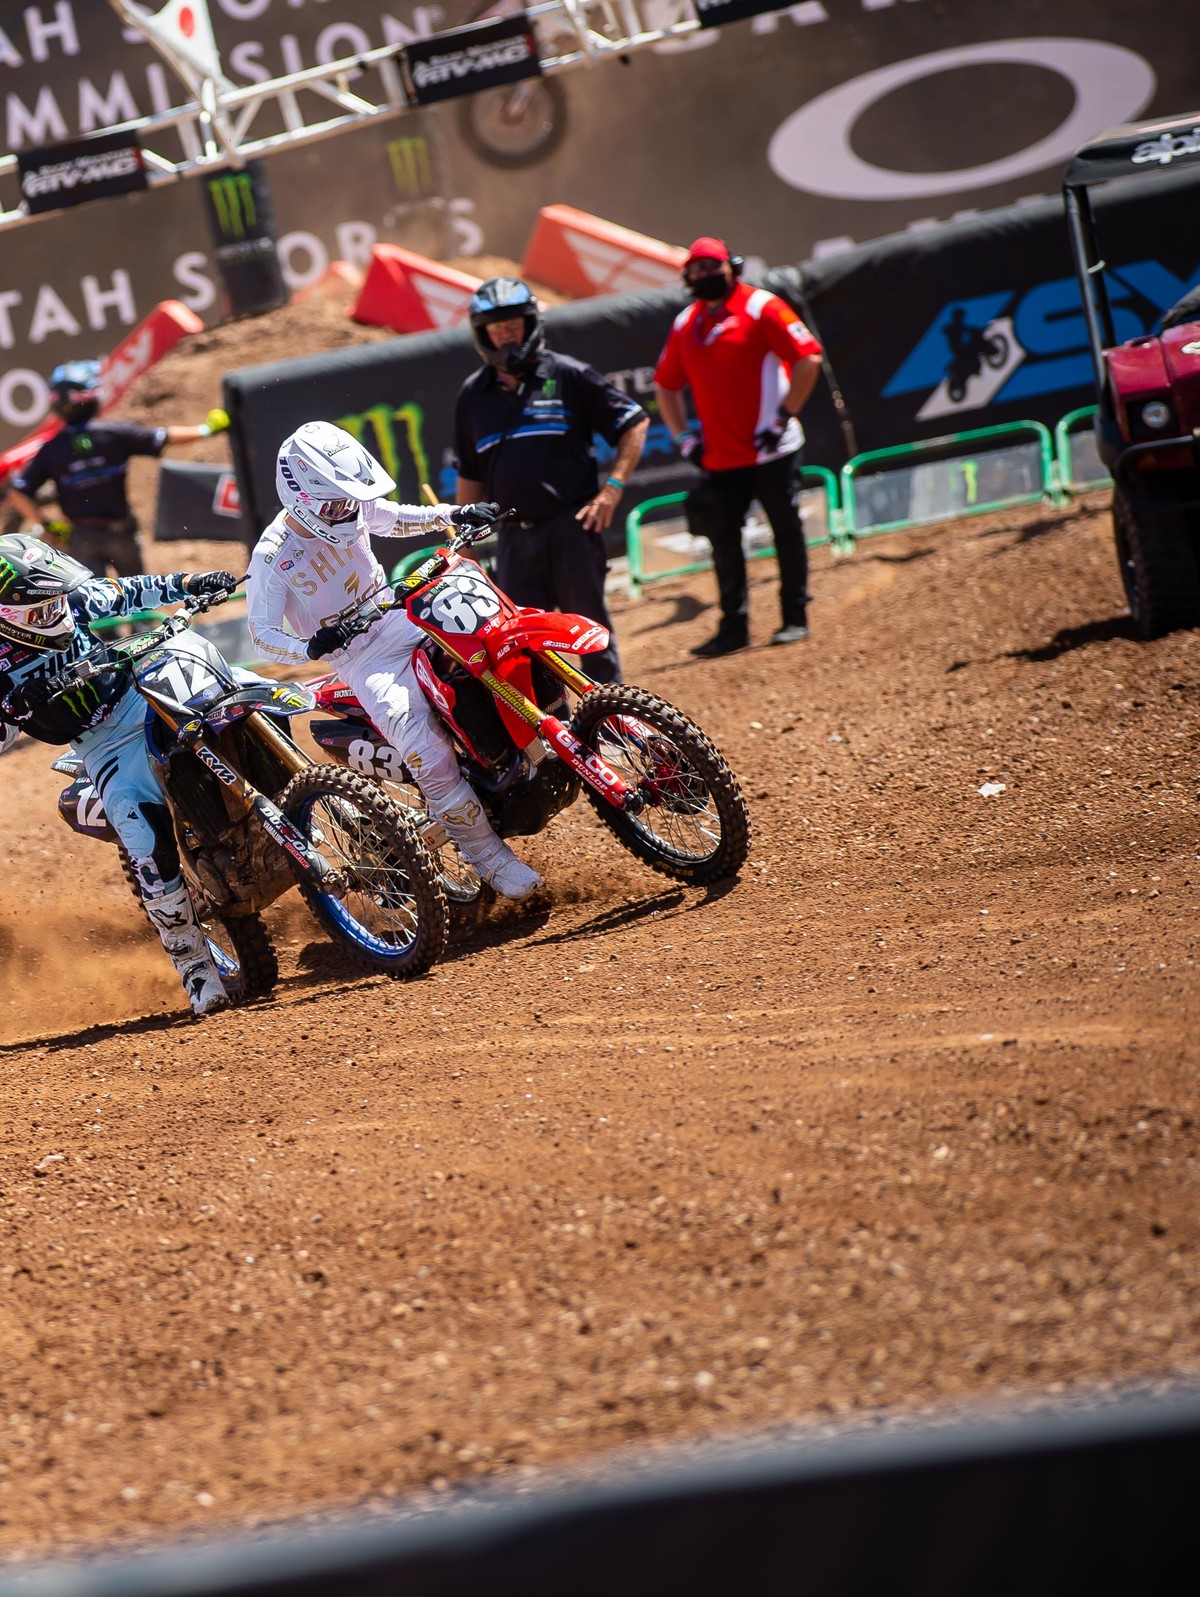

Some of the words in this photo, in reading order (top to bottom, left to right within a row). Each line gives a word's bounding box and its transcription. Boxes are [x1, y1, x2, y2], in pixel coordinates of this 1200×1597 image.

[293, 506, 341, 544] GEICO
[431, 568, 502, 635] 83
[572, 626, 602, 650] GEICO
[157, 641, 217, 705] 12
[347, 739, 404, 783] 83
[555, 729, 620, 787] GECO
[570, 758, 609, 792] DUNLOP
[76, 785, 107, 827] 12
